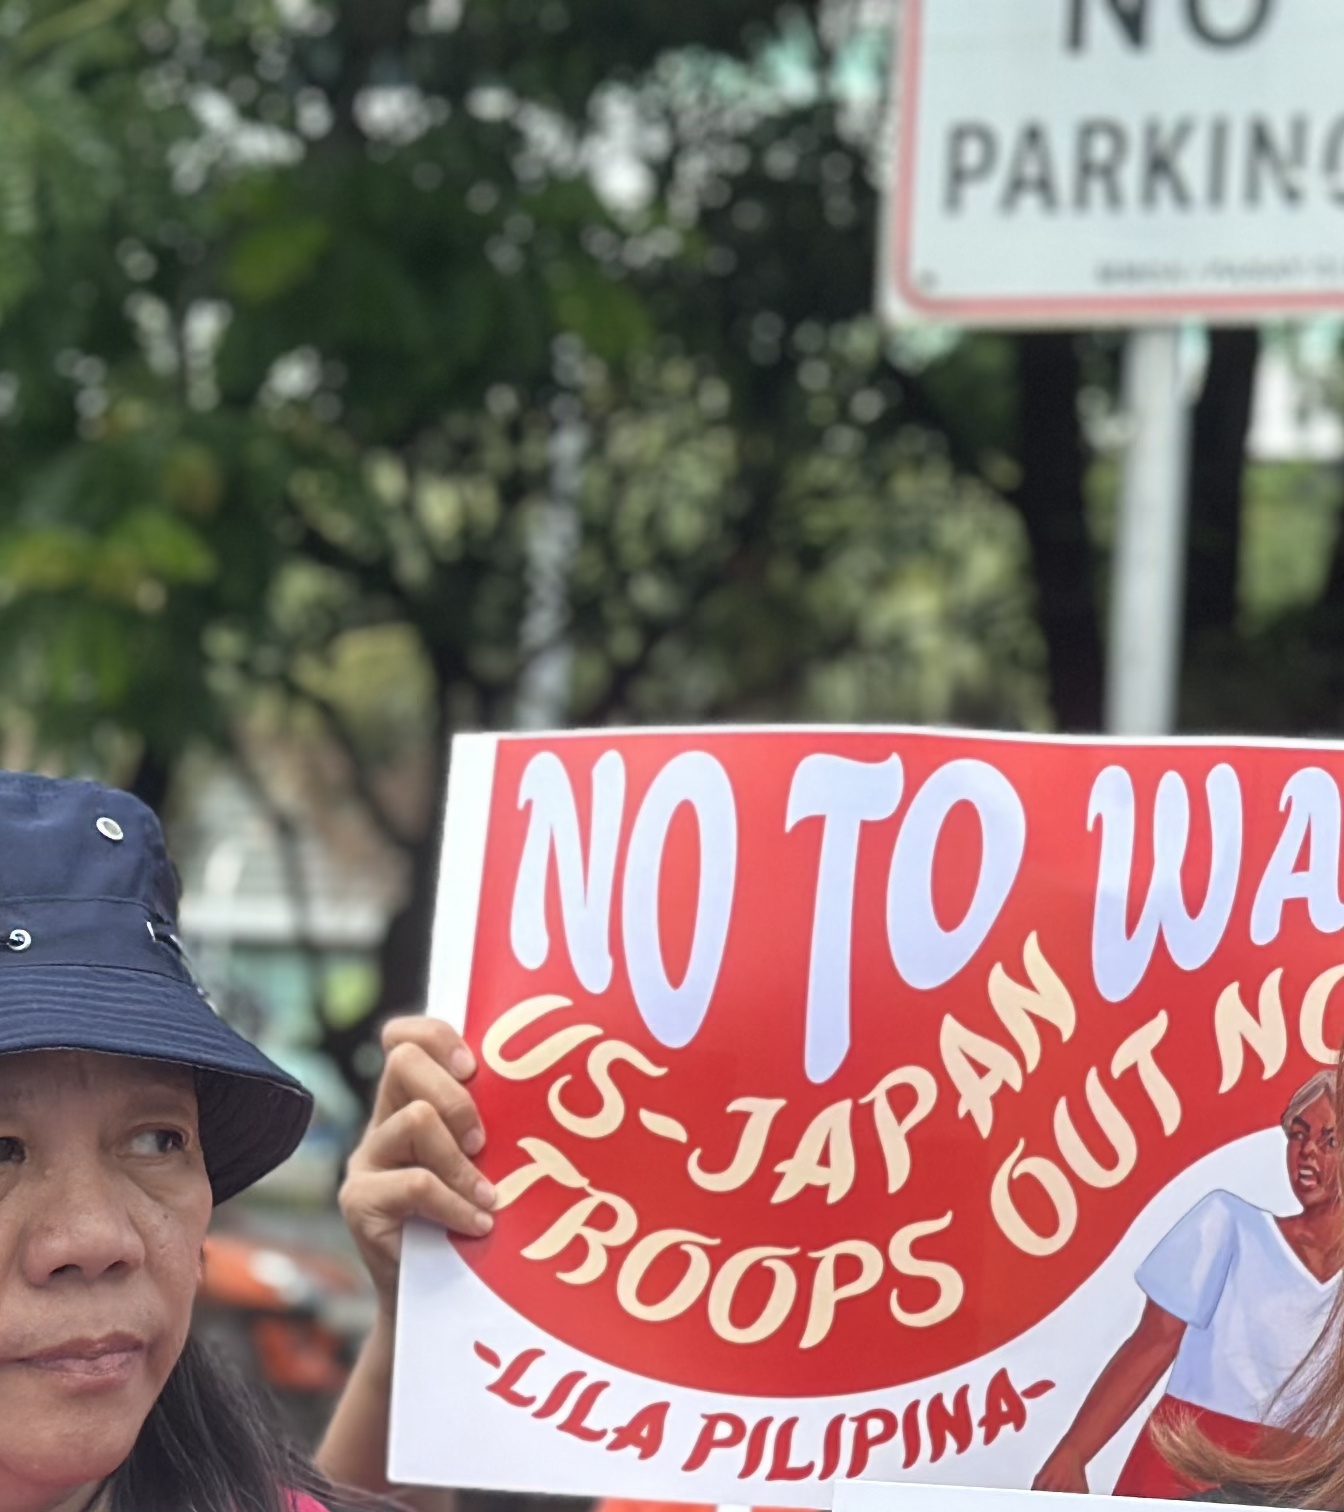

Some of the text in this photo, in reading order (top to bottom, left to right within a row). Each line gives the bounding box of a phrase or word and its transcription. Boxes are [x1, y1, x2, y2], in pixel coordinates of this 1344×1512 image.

[482, 930, 1077, 1204] US-JAPAN
[510, 749, 737, 1048] NO
[785, 752, 1026, 1083] TO
[493, 1137, 964, 1349] TROOPS
[990, 1009, 1182, 1257] OUT
